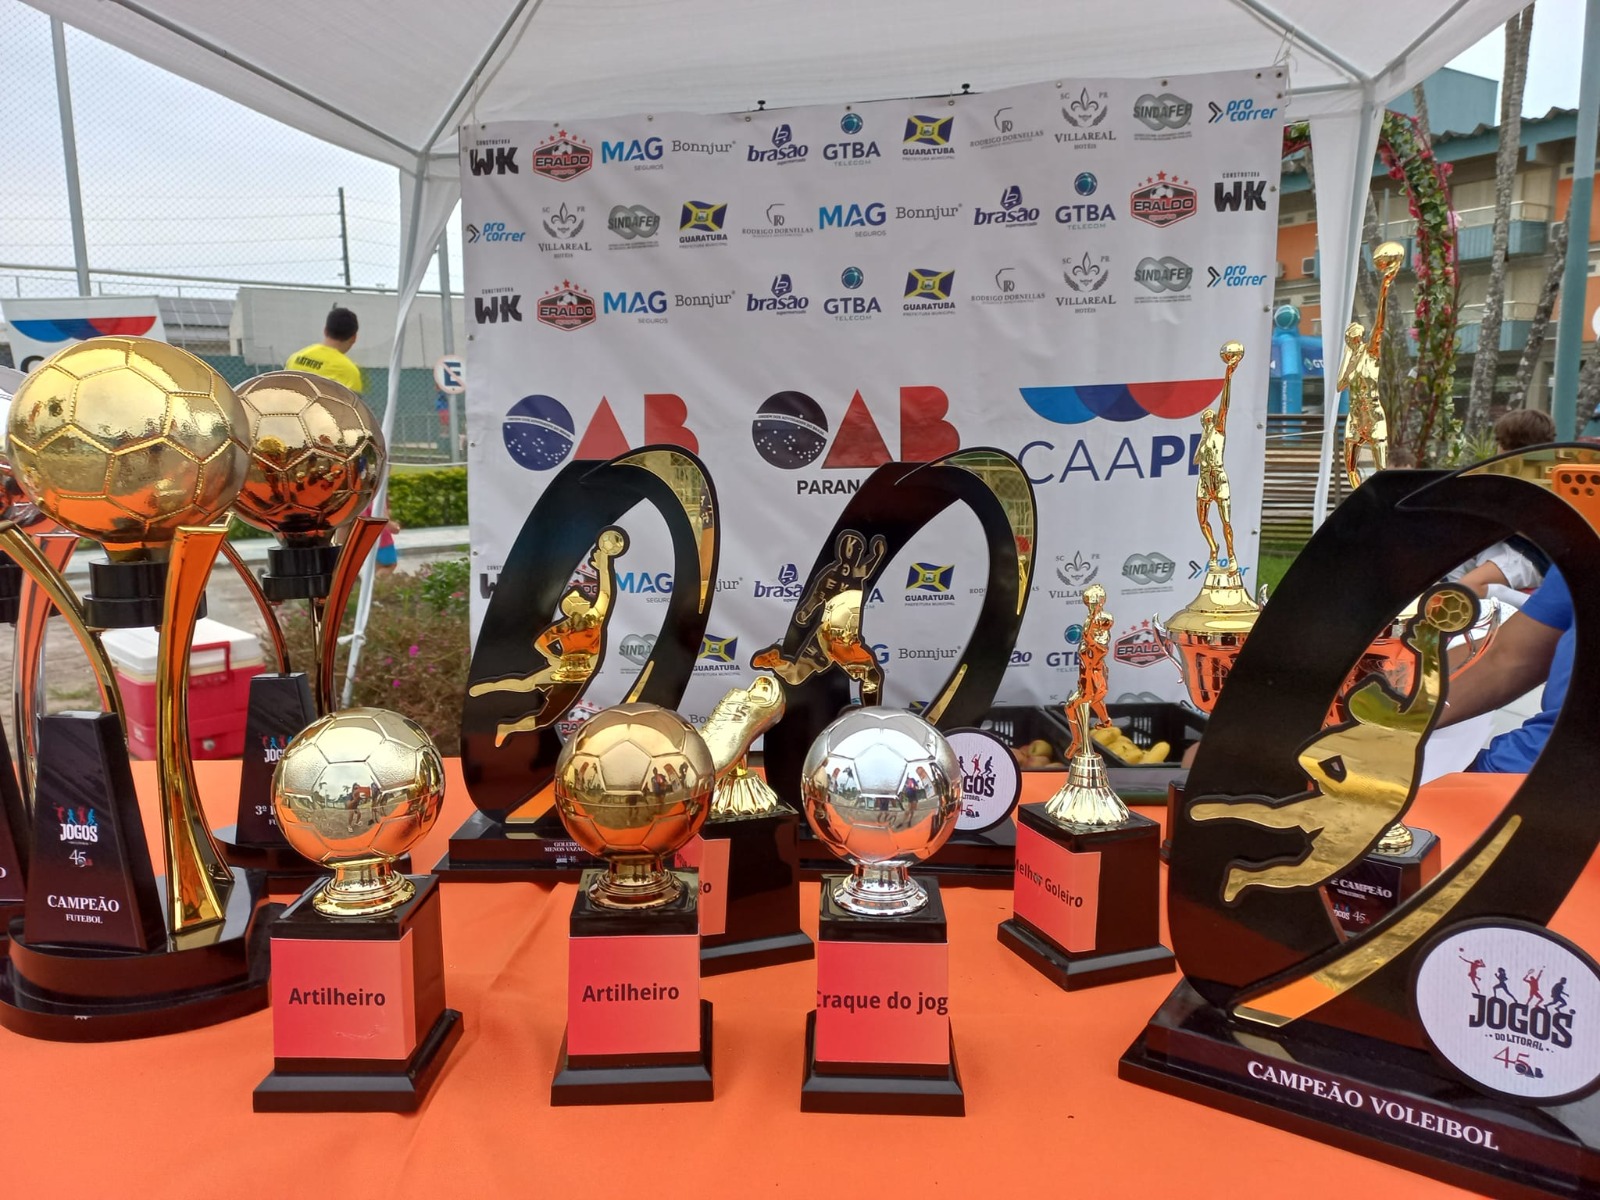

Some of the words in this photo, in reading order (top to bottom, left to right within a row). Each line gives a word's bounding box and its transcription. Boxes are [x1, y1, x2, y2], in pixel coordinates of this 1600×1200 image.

[1226, 98, 1253, 112] pro
[1230, 108, 1278, 122] correr
[1054, 130, 1116, 143] VILLAREAL
[601, 137, 664, 164] MAG
[671, 140, 732, 155] Bonnjur
[747, 144, 808, 162] brasão
[823, 141, 881, 160] GTBA
[902, 147, 956, 156] GUARATUBA
[469, 146, 519, 176] WK
[535, 155, 590, 167] ERALDO
[1134, 198, 1194, 212] ERALDO
[1214, 181, 1267, 212] WK
[819, 202, 886, 230] MAG
[896, 206, 958, 220] Bonnjur
[974, 207, 1040, 225] brasão
[1055, 204, 1116, 224] GTBA
[483, 222, 505, 236] pro
[486, 231, 526, 242] correr
[538, 242, 592, 252] VILLAREAL
[679, 234, 728, 244] GUARATUBA
[1224, 265, 1246, 279] pro
[1227, 274, 1268, 287] correr
[474, 294, 522, 324] WK
[604, 290, 667, 314] MAG
[675, 293, 732, 308] Bonnjur
[747, 294, 809, 312] brasão
[824, 297, 882, 314] GTBA
[903, 302, 956, 311] GUARATUBA
[1056, 295, 1116, 306] VILLAREAL
[540, 306, 594, 316] ERALDO
[797, 480, 867, 494] PARAN
[616, 572, 672, 593] MAG
[754, 581, 804, 598] brasã
[898, 648, 958, 660] Bonnjur
[1118, 644, 1161, 655] ERALD
[264, 748, 286, 762] JOG
[963, 776, 994, 798] GOS
[60, 824, 98, 842] JOGOS
[1044, 878, 1082, 908] Goleiro
[1340, 879, 1392, 898] CAMPEÃO
[47, 894, 120, 912] CAMPEÃO
[66, 914, 103, 924] FUTEBOL
[288, 988, 386, 1006] Artilheiro
[582, 983, 680, 1002] Artilheiro
[887, 991, 912, 1009] do
[1469, 993, 1573, 1048] JOGOS
[1506, 1034, 1544, 1052] LITORAL
[1247, 1060, 1363, 1108] CAMPEÃO
[1369, 1096, 1499, 1150] VOLEIBOL
